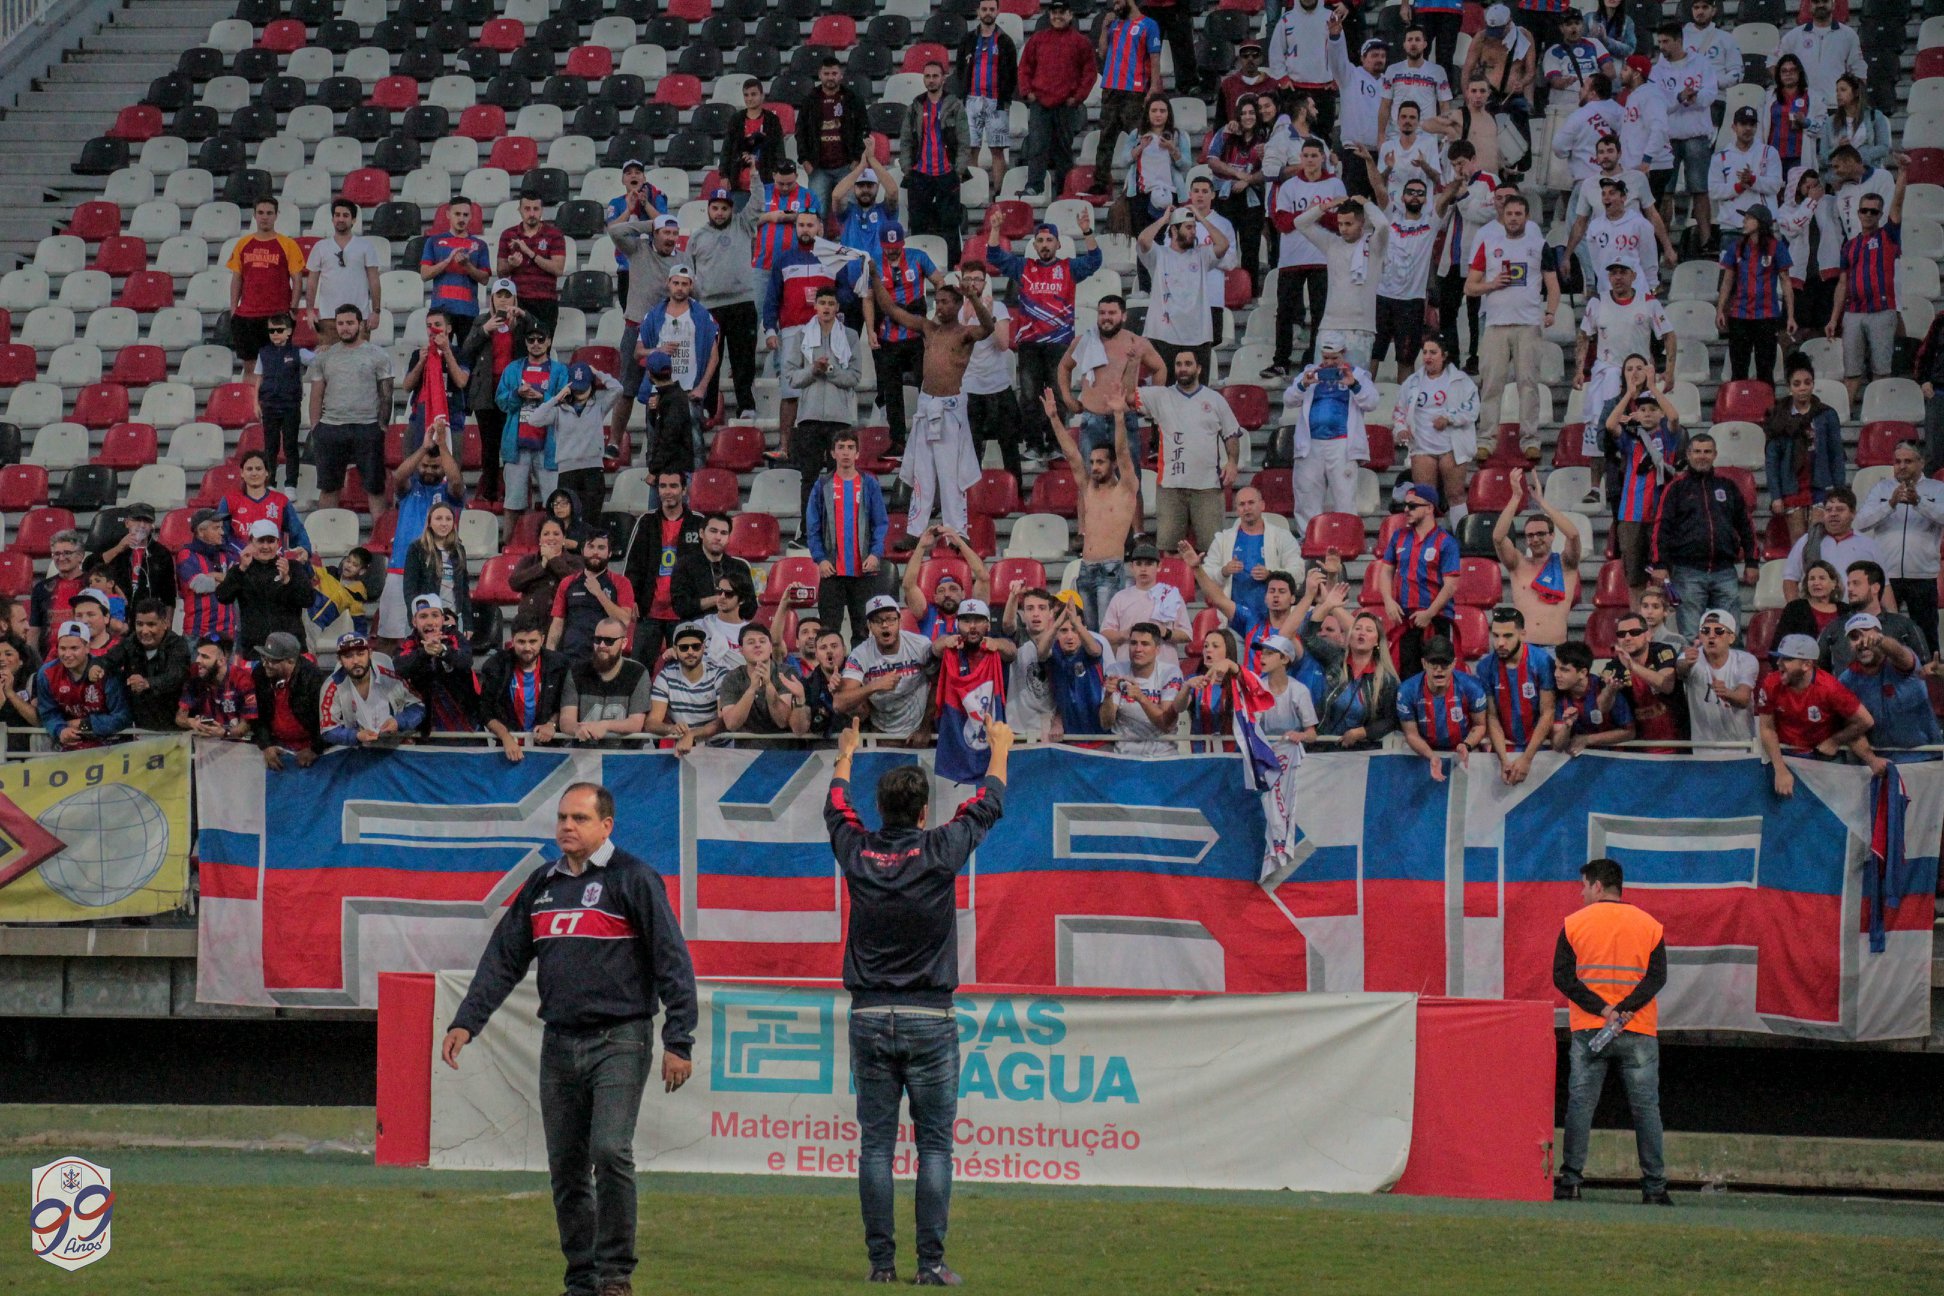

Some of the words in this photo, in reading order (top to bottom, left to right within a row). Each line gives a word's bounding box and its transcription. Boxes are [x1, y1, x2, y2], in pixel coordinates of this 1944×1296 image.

[685, 532, 700, 544] 82
[0, 753, 165, 790] logia
[550, 912, 584, 935] CT
[711, 1111, 858, 1142] Materiais
[952, 1117, 1141, 1157] Construção
[767, 1152, 785, 1171] e
